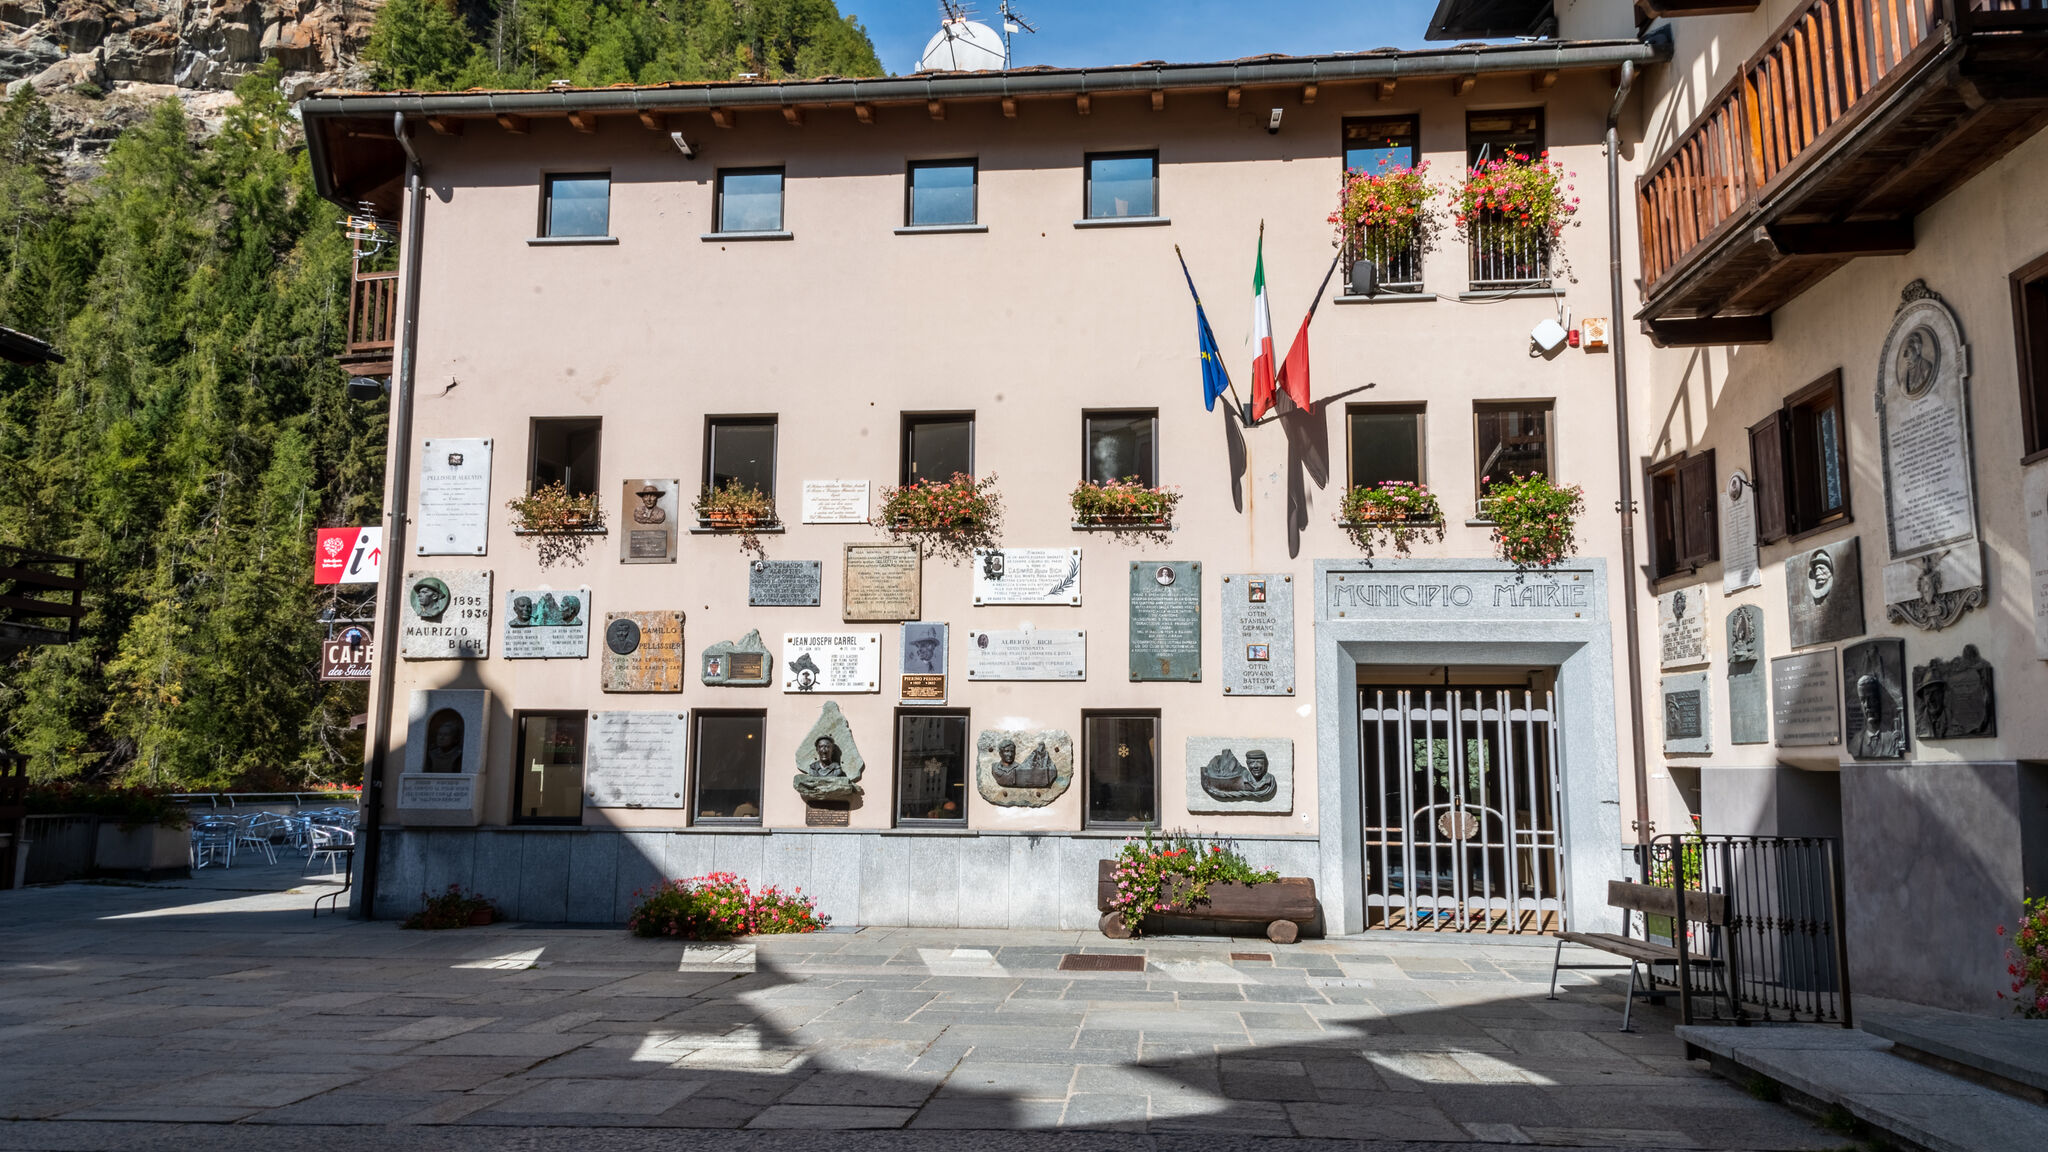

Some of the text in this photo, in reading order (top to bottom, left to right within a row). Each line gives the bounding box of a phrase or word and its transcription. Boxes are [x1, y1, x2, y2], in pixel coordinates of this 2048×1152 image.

[1333, 584, 1588, 607] MUNICIPIO MAIRIE
[454, 596, 481, 606] 1895
[461, 609, 488, 618] 1936
[406, 627, 468, 636] MAURIZIO
[448, 640, 482, 649] BICH
[638, 642, 681, 650] PELLISSIER
[792, 636, 857, 646] JEAN JOSEPH CARREL
[329, 643, 372, 664] CAFÉ
[328, 664, 372, 676] des Guide
